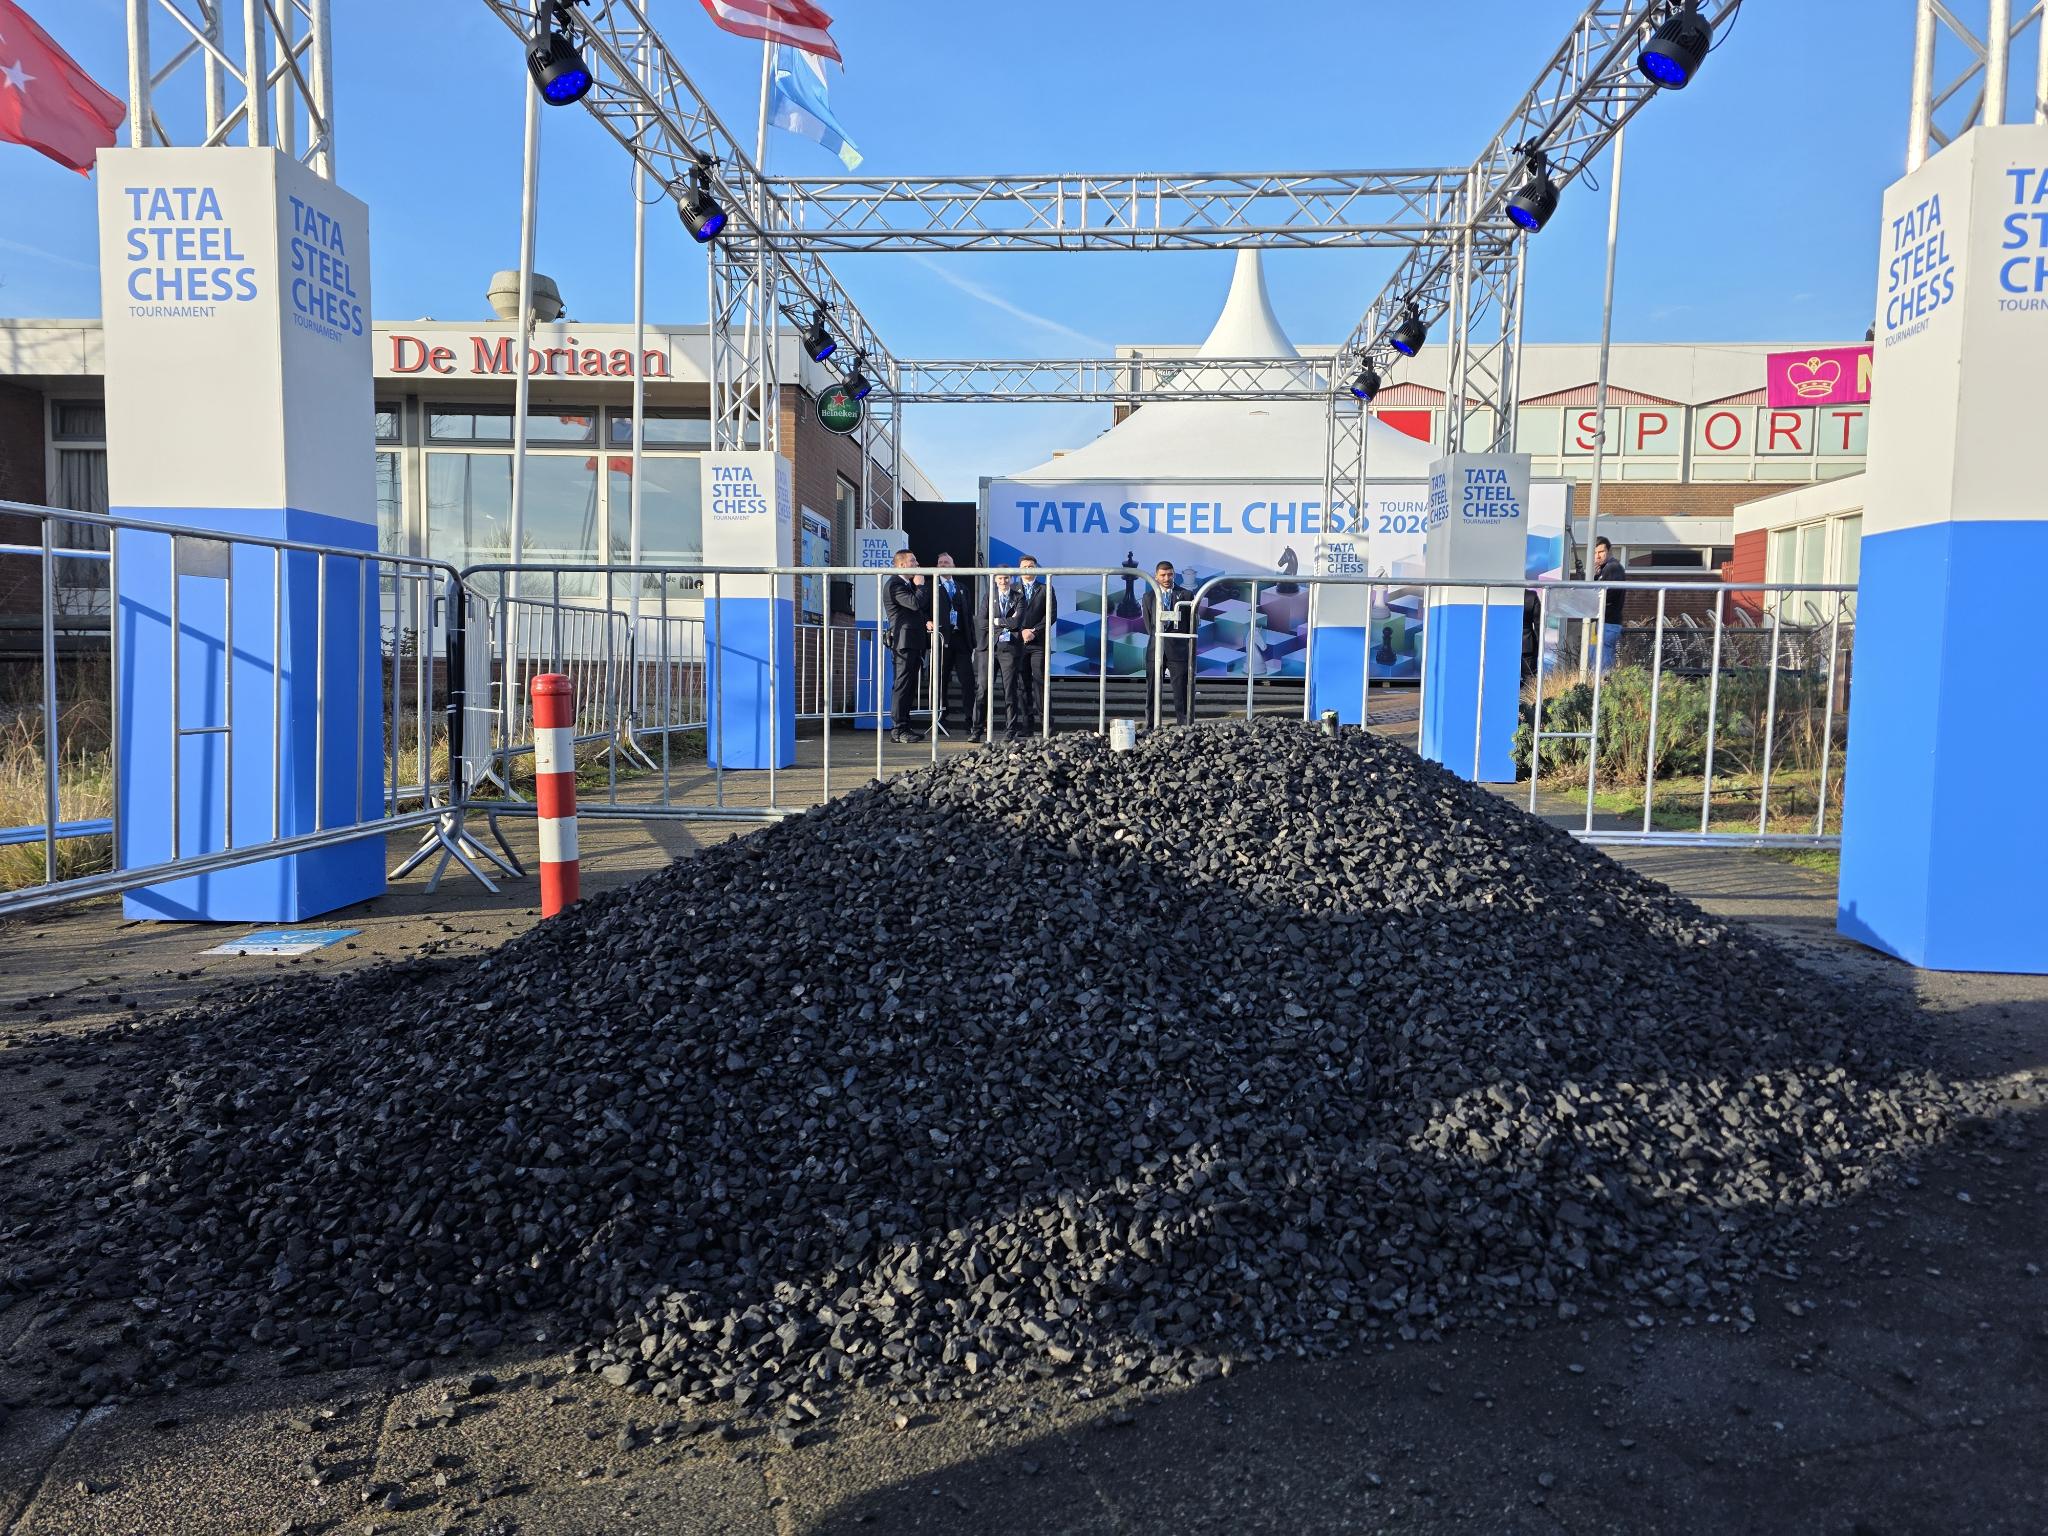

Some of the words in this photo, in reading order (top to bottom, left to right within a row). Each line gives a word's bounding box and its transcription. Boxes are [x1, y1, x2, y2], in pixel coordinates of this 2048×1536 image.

[125, 187, 223, 220] TATA
[289, 195, 345, 256] TATA
[1892, 192, 1941, 252] TATA
[127, 228, 245, 261] STEEL
[291, 237, 356, 298] STEEL
[1888, 230, 1950, 293] STEEL
[128, 267, 257, 301] CHESS
[1886, 266, 1955, 330] CHESS
[128, 306, 216, 318] TOURNAMENT
[292, 278, 363, 337] CHESS
[293, 313, 343, 344] TOURNAMENT
[1885, 318, 1930, 348] TOURNAMENT
[389, 335, 457, 374] De
[469, 336, 670, 377] Moriaan
[821, 409, 858, 418] Heineken
[1576, 411, 1863, 451] SPORT
[712, 467, 753, 481] TATA
[1432, 473, 1446, 490] TATA
[1465, 469, 1508, 484] TATA
[713, 484, 762, 497] STEEL
[1430, 489, 1448, 507] STEEL
[1463, 486, 1516, 500] STEEL
[713, 500, 767, 514] CHESS
[1430, 505, 1449, 523] CHESS
[1463, 503, 1520, 518] CHESS
[1016, 501, 1109, 533] TATA
[1119, 502, 1233, 534] STEEL
[1242, 502, 1369, 534] CHESS
[862, 539, 889, 548] TATA
[1327, 543, 1355, 552] TATA
[862, 550, 894, 558] STEEL
[1327, 554, 1361, 562] STEEL
[1327, 563, 1364, 573] CHESS
